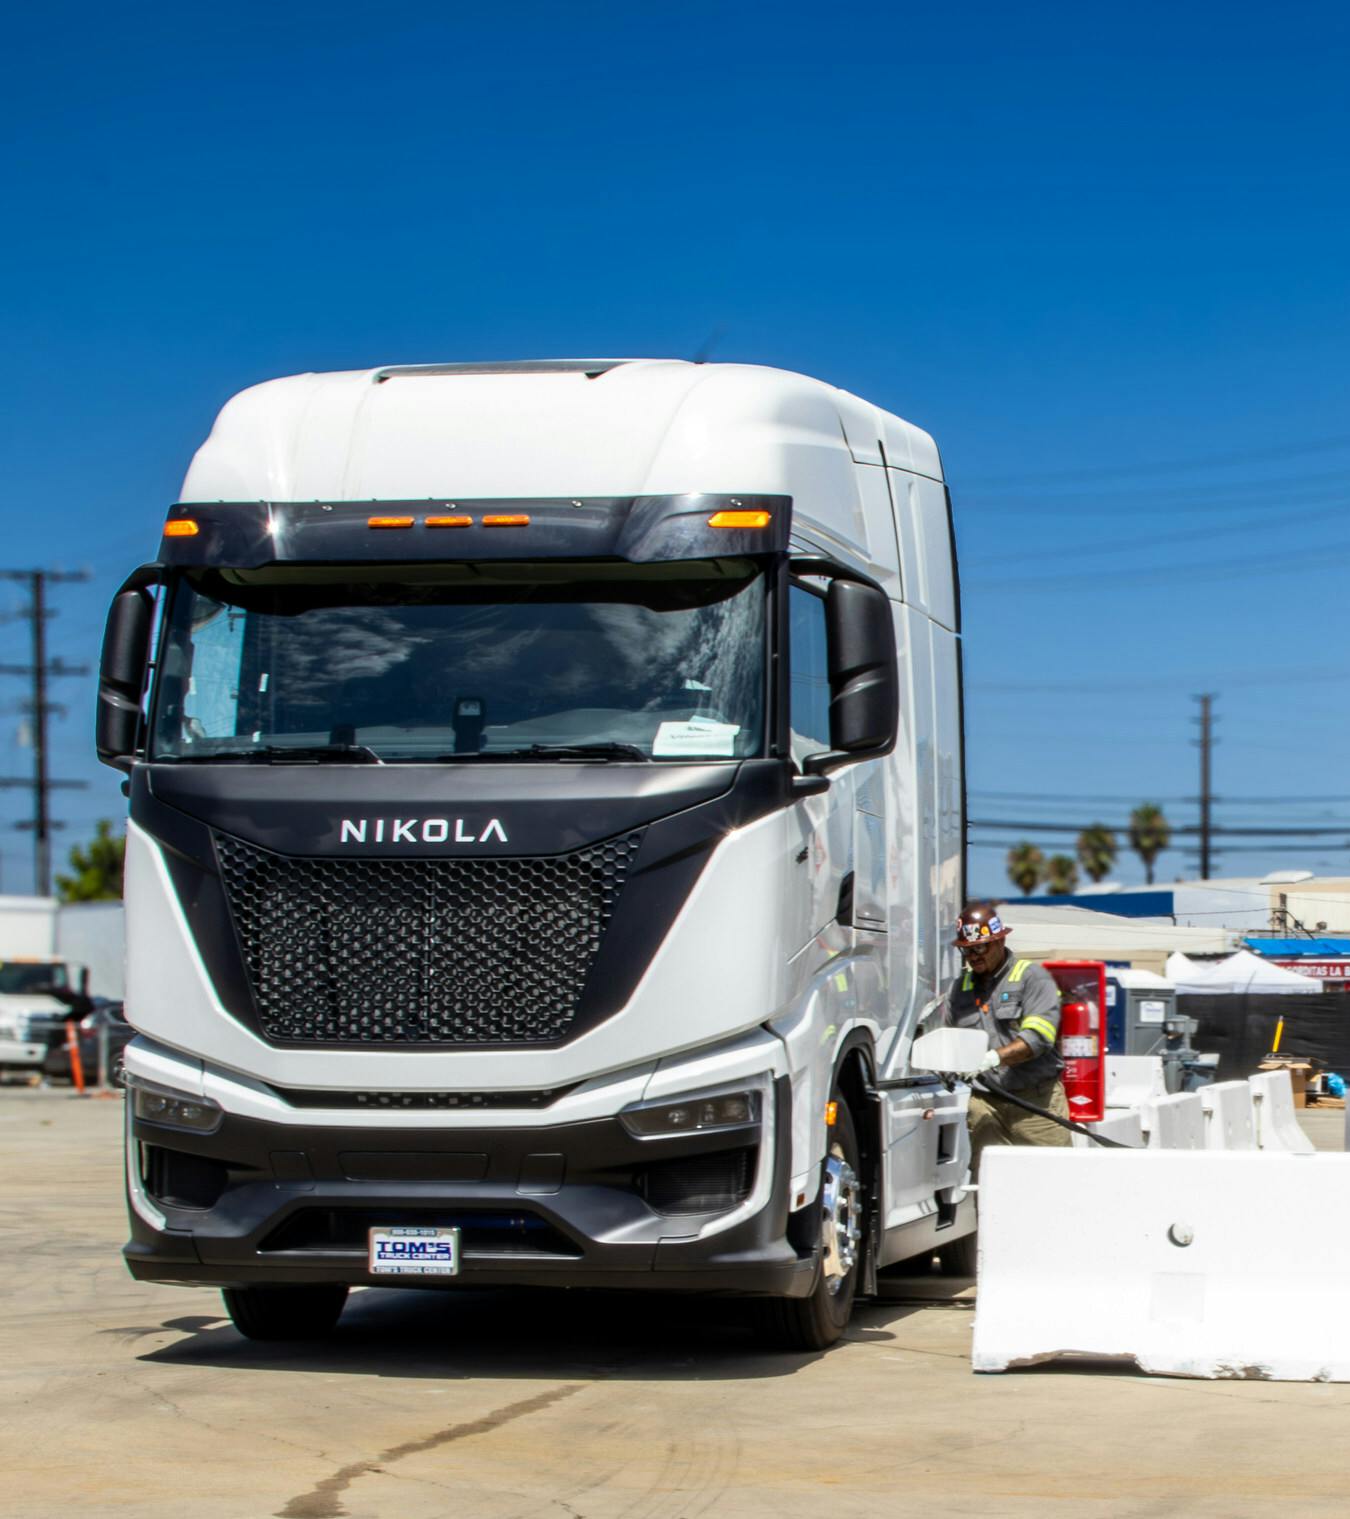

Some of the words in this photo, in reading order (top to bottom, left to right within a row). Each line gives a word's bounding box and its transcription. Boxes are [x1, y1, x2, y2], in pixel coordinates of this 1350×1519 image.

[340, 818, 508, 843] NIKOLA
[1329, 966, 1342, 977] LA
[376, 1241, 450, 1254] TOM'S
